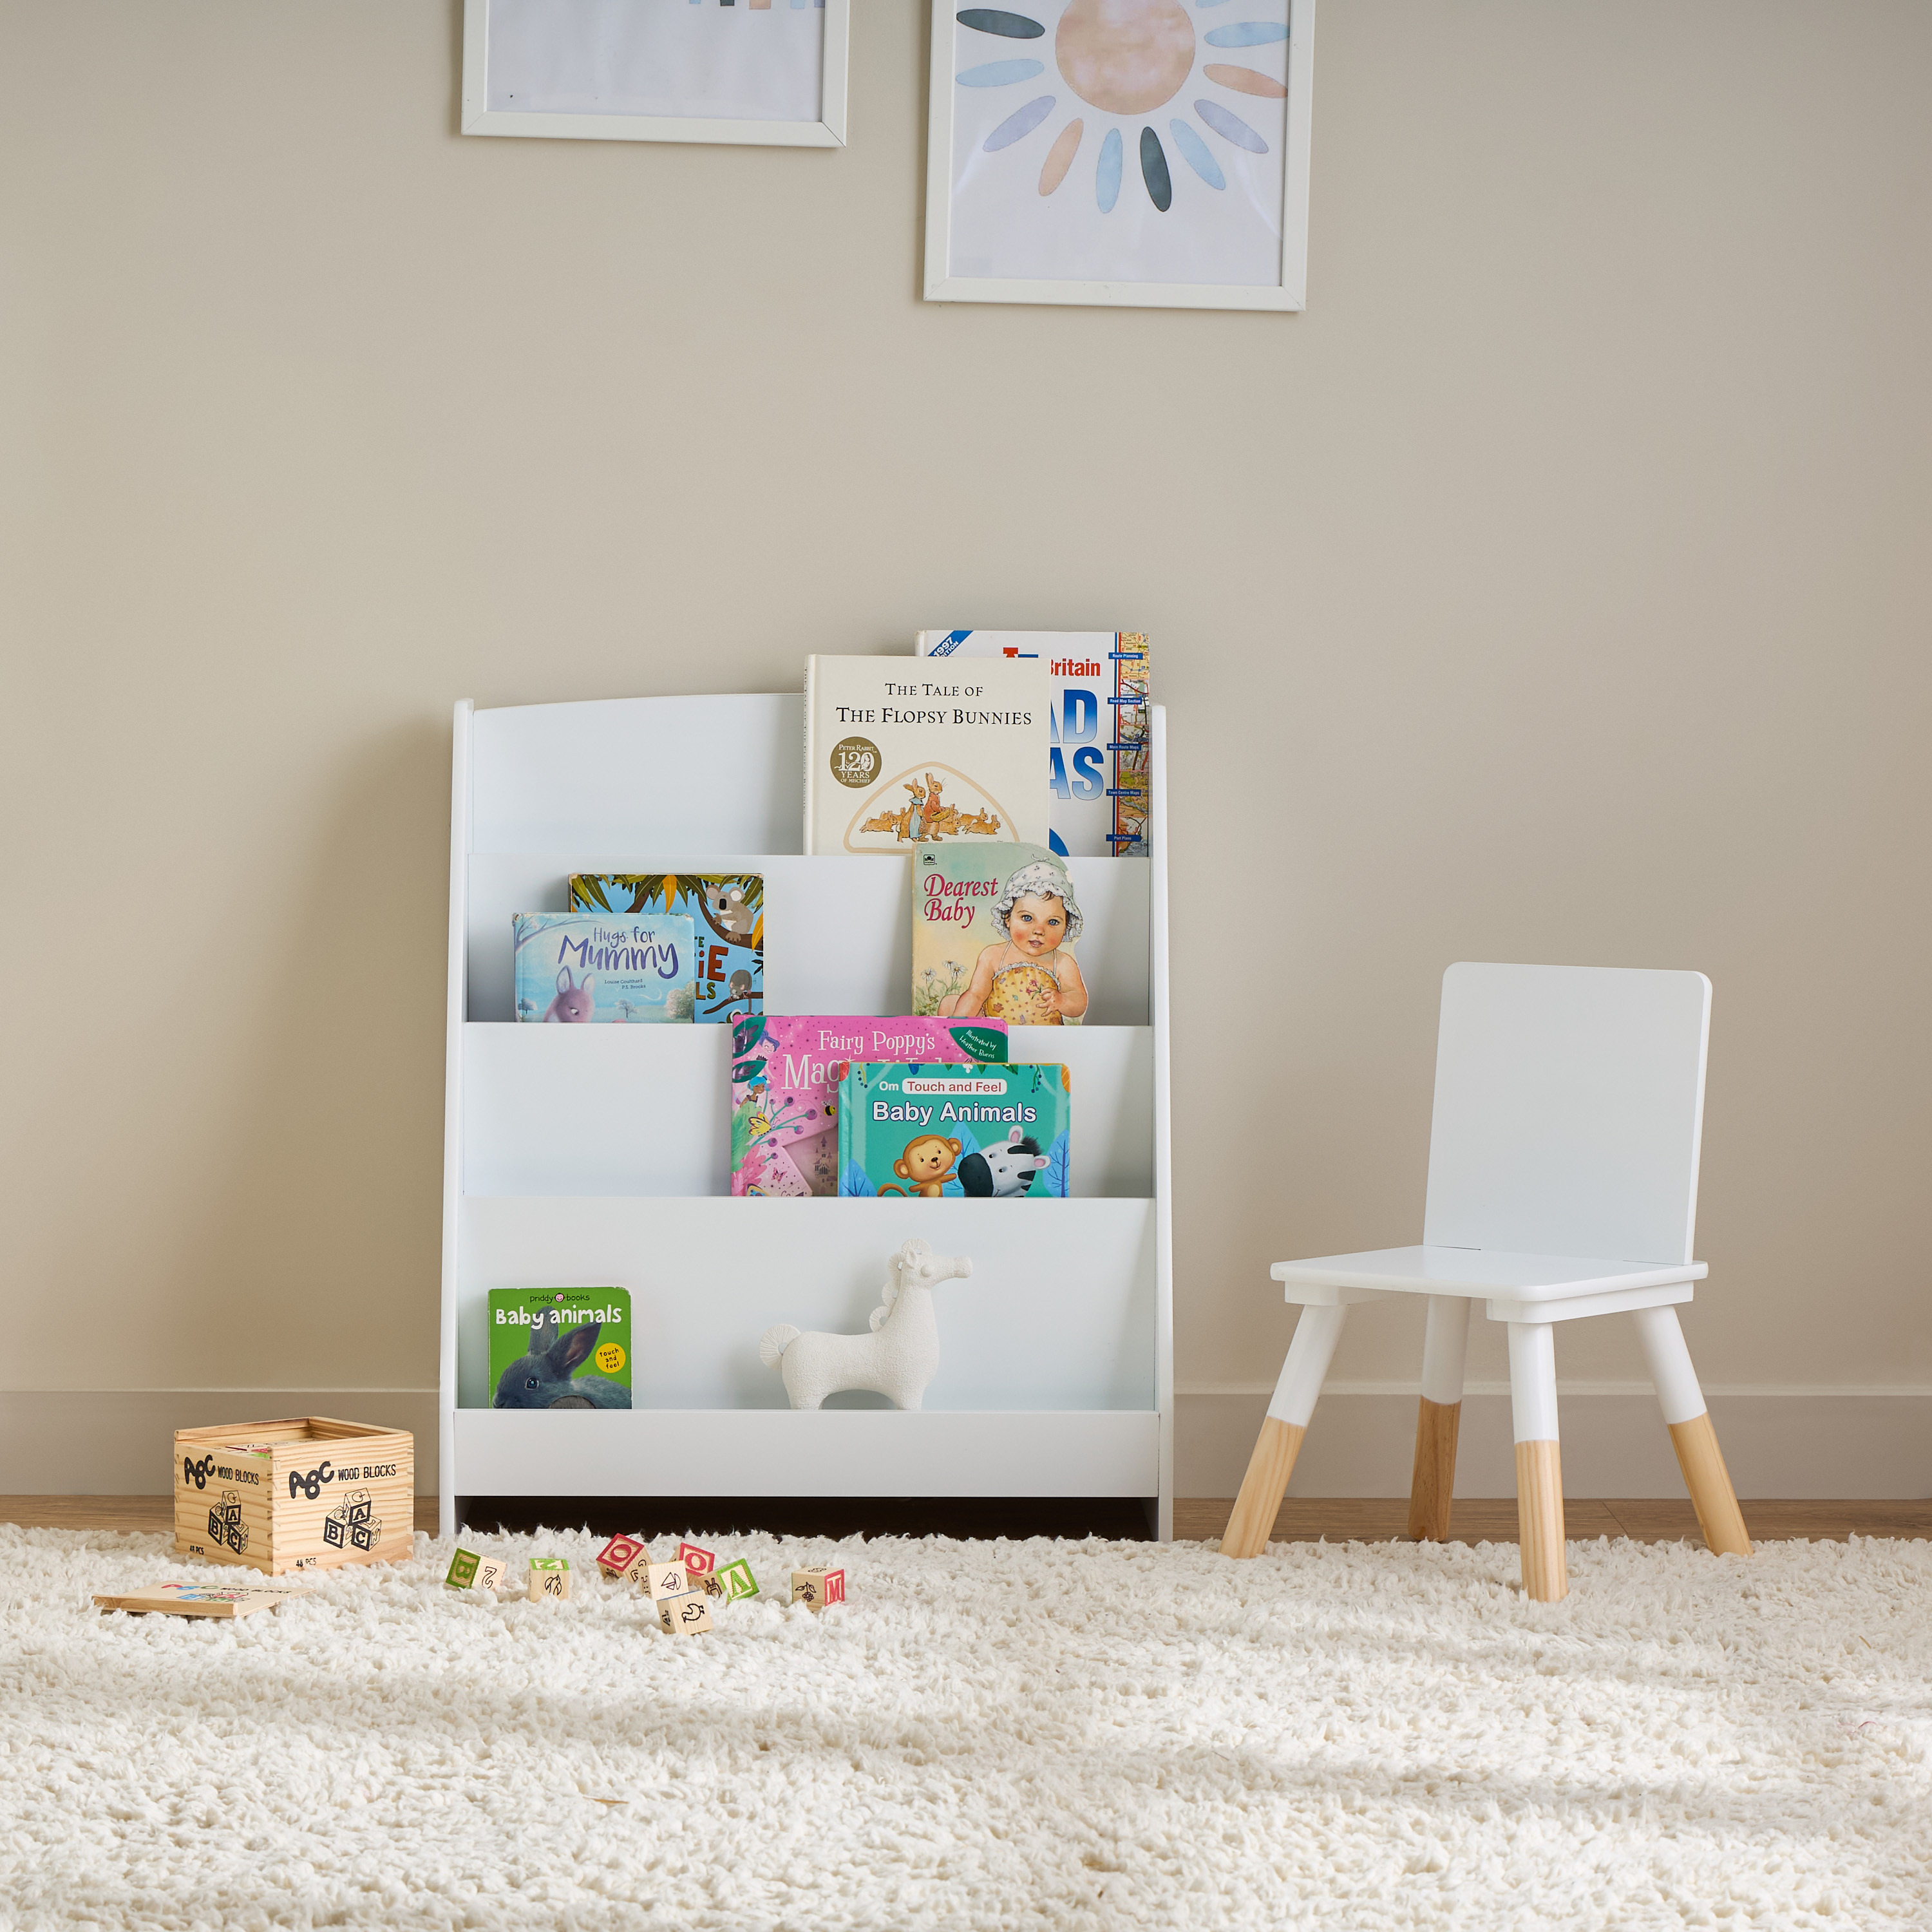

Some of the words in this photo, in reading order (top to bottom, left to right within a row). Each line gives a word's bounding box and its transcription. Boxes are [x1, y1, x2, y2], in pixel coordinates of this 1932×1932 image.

[934, 636, 953, 656] 1997
[942, 641, 959, 656] DITION
[1050, 658, 1101, 676] ritain
[884, 683, 917, 696] THE
[922, 683, 960, 697] TALE
[835, 706, 875, 723] THE
[881, 707, 948, 724] FLOPSY
[952, 708, 1032, 725] BUNNIES
[838, 751, 875, 772] 120
[923, 873, 998, 897] Dearest
[923, 897, 975, 929] Baby
[594, 927, 627, 949] Hugs
[631, 925, 656, 943] for
[558, 934, 679, 979] Mummy
[817, 1030, 864, 1055] Fairy
[871, 1031, 935, 1056] Poppy's
[966, 1029, 990, 1047] Illustrated
[990, 1041, 997, 1051] by
[878, 1081, 899, 1091] Om
[907, 1081, 945, 1092] Touch
[948, 1081, 972, 1092] and
[976, 1081, 1001, 1092] Feel
[872, 1101, 933, 1126] Baby
[940, 1102, 1037, 1123] Animals
[530, 1294, 553, 1303] priddy
[496, 1306, 544, 1330] Baby
[549, 1304, 622, 1323] animals
[600, 1347, 619, 1357] touch
[218, 1466, 233, 1480] WOOD
[235, 1469, 259, 1485] BLOCKS
[338, 1467, 359, 1481] WOOD
[363, 1464, 396, 1479] BLOCKS
